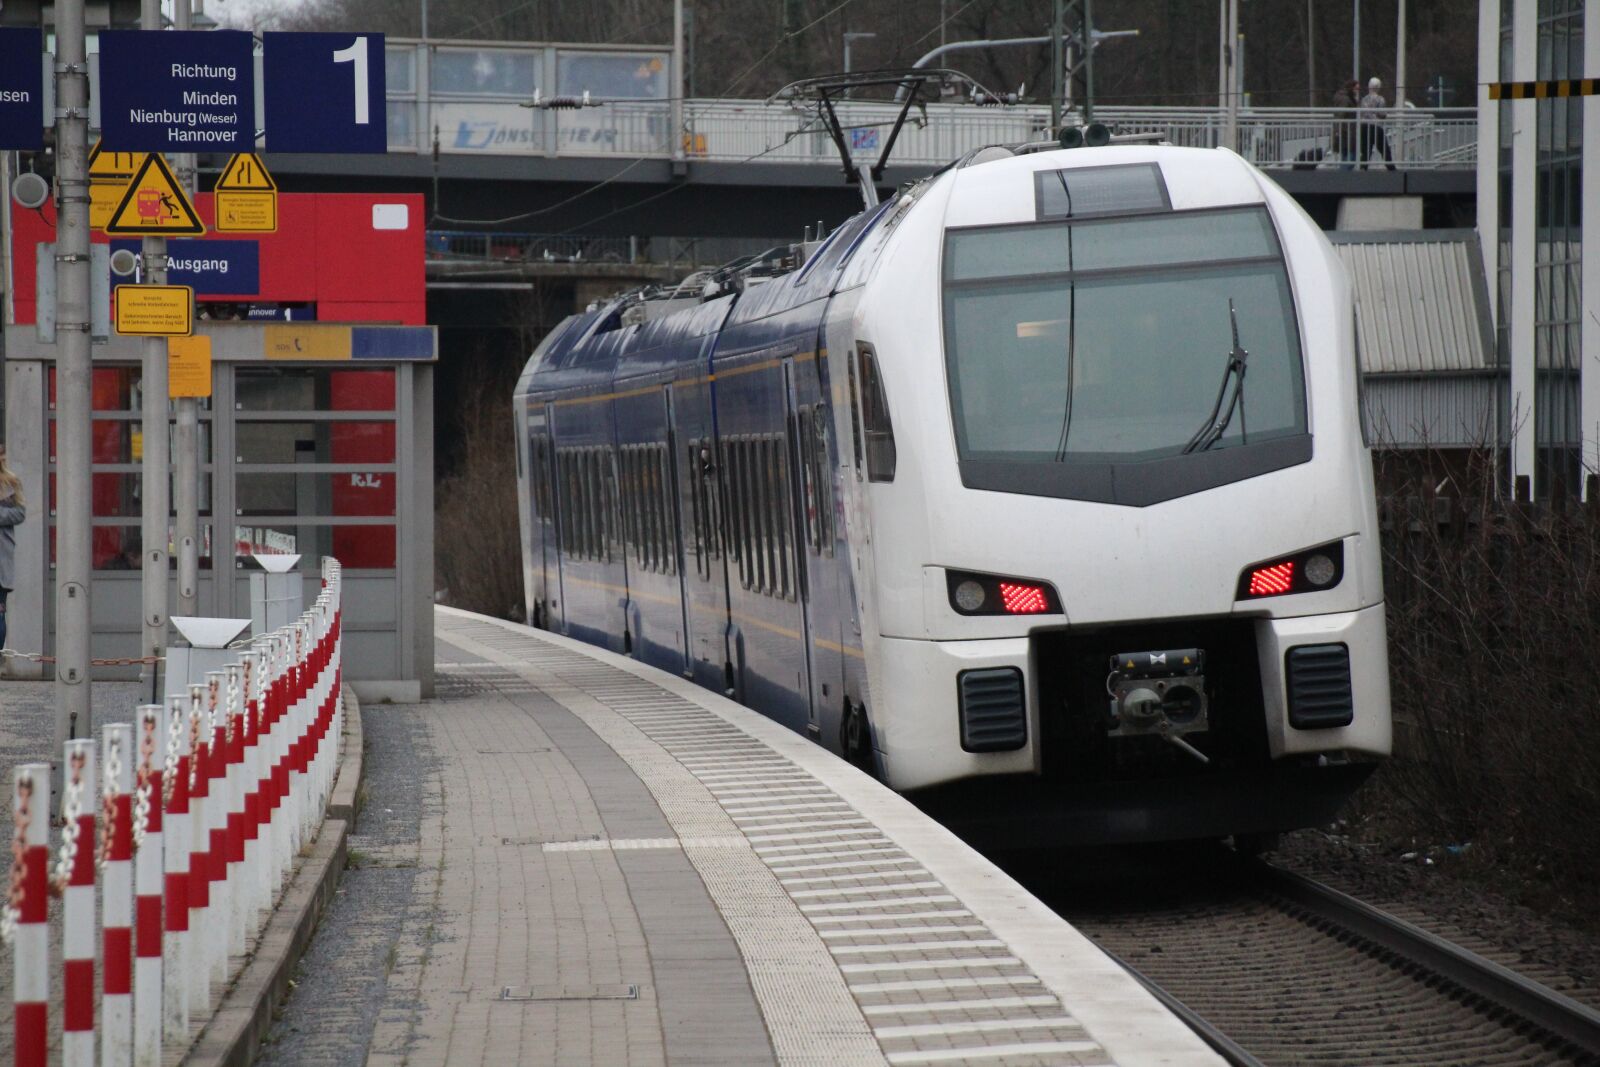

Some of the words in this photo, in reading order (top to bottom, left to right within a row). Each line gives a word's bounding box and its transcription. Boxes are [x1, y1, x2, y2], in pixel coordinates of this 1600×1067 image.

[171, 63, 236, 81] Richtung
[333, 36, 369, 124] 1
[0, 90, 30, 102] sen
[183, 91, 237, 105] Minden
[130, 109, 197, 126] Nienburg
[198, 112, 237, 125] (Weser)
[168, 128, 238, 142] Hannover
[166, 256, 228, 273] Ausgang
